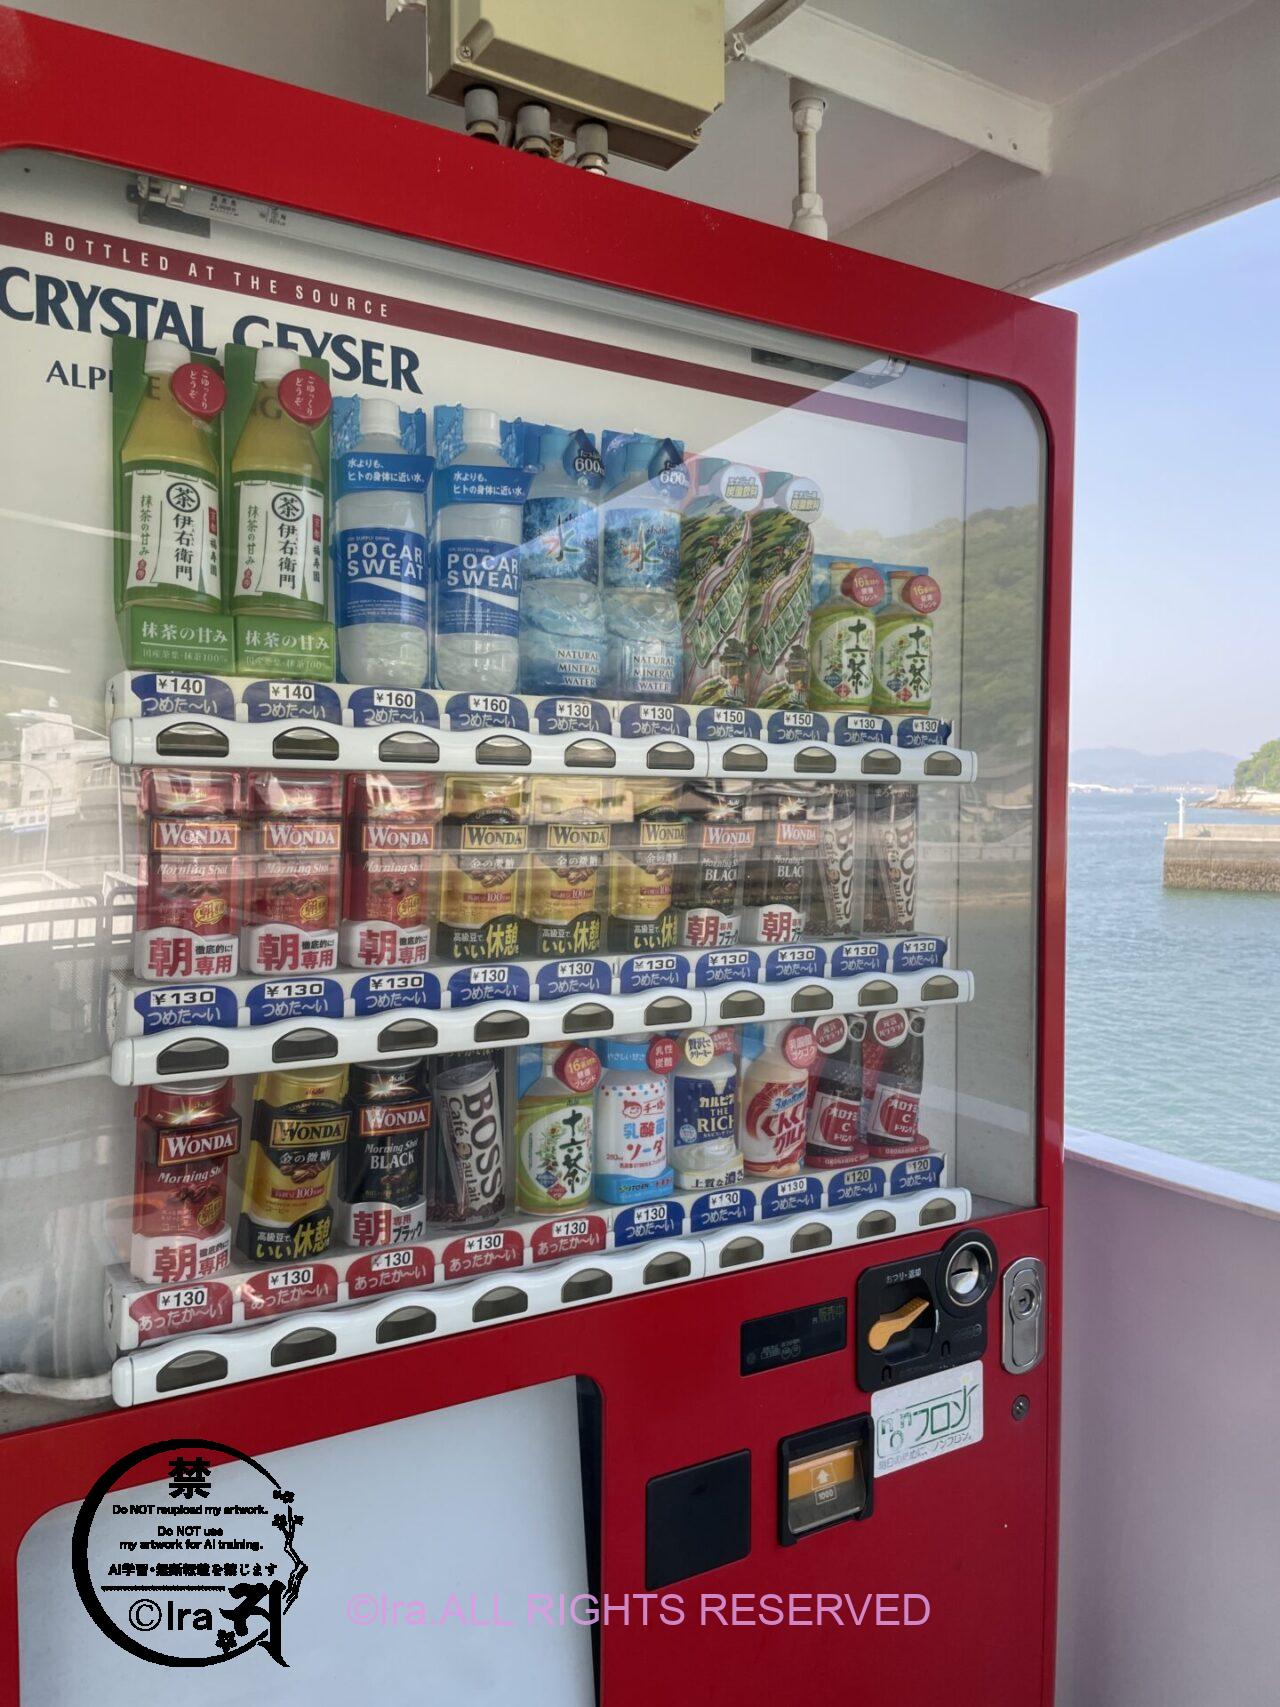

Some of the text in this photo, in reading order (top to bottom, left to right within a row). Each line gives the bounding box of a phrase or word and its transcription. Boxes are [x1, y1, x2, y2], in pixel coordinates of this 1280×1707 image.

[44, 231, 389, 317] BOTTLED AT THE SOURCE
[0, 266, 217, 356] CRYSTAL
[348, 458, 385, 468] 水よりも、
[348, 471, 425, 483] ヒトの身体に近い水。
[453, 472, 488, 482] 水よりも、
[172, 486, 197, 509] 茶
[453, 484, 524, 496] ヒトの身体に近い水。
[277, 496, 300, 518] 茶
[173, 513, 194, 582] 伊右衛門
[278, 523, 298, 590] 伊右衛門
[347, 559, 424, 581] SWEAT
[447, 570, 519, 591] SWEAT
[142, 621, 228, 644] 抹茶の甘み
[245, 629, 330, 651] 抹茶の甘み
[845, 618, 869, 695] 十六茶
[905, 625, 929, 698] 十六茶
[158, 678, 203, 694] ¥140
[564, 676, 597, 688] WATER
[638, 681, 671, 692] WATER
[271, 685, 313, 700] ¥140
[376, 692, 413, 707] ¥160
[473, 697, 507, 713] ¥160
[558, 703, 589, 717] ¥130
[642, 707, 673, 720] ¥130
[716, 710, 744, 724] ¥150
[785, 713, 811, 726] ¥150
[852, 719, 876, 729] ¥130
[159, 822, 232, 845] WONDA
[269, 824, 335, 846] WONDA
[368, 825, 429, 846] WONDA
[467, 825, 522, 846] WONDA
[552, 825, 606, 845] WONDA
[646, 822, 686, 842] WONDA
[708, 827, 751, 845] WONDA
[780, 823, 817, 841] WONDA
[686, 914, 720, 947] 朝
[761, 911, 793, 943] 朝
[257, 933, 300, 973] 朝
[359, 929, 398, 966] 朝
[398, 944, 427, 965] 専用
[780, 950, 814, 961] ¥130
[844, 946, 877, 956] ¥130
[904, 941, 935, 952] ¥130
[148, 937, 193, 977] 朝
[195, 955, 232, 976] 専用
[302, 949, 333, 969] 専用
[635, 959, 675, 970] ¥130
[709, 954, 748, 966] ¥130
[473, 968, 506, 983] ¥130
[560, 963, 592, 976] ¥130
[266, 983, 323, 997] ¥130
[371, 976, 422, 989] ¥130
[154, 990, 214, 1005] ¥130
[365, 1106, 426, 1130] WONDA
[710, 1107, 729, 1116] THE
[902, 1113, 911, 1123] C
[278, 1119, 342, 1143] WONDA
[841, 1122, 851, 1132] C
[166, 1132, 233, 1159] WONDA
[365, 1142, 403, 1154] Morning
[463, 1083, 502, 1198] BOSS
[626, 1136, 665, 1161] ソーダ
[449, 1097, 481, 1203] Café au Lait
[559, 1109, 587, 1194] 十六茶
[370, 1151, 415, 1170] BLACK
[158, 1169, 208, 1184] Morning
[780, 1180, 805, 1193] ¥130
[711, 1193, 739, 1205] ¥130
[635, 1206, 666, 1220] ¥130
[353, 1209, 392, 1247] 朝
[393, 1221, 423, 1243] ブラック
[555, 1221, 586, 1235] ¥130
[467, 1235, 501, 1249] ¥130
[153, 1243, 197, 1283] 朝
[198, 1249, 229, 1277] 専用
[270, 1269, 311, 1285] ¥130
[161, 1290, 205, 1307] ¥130
